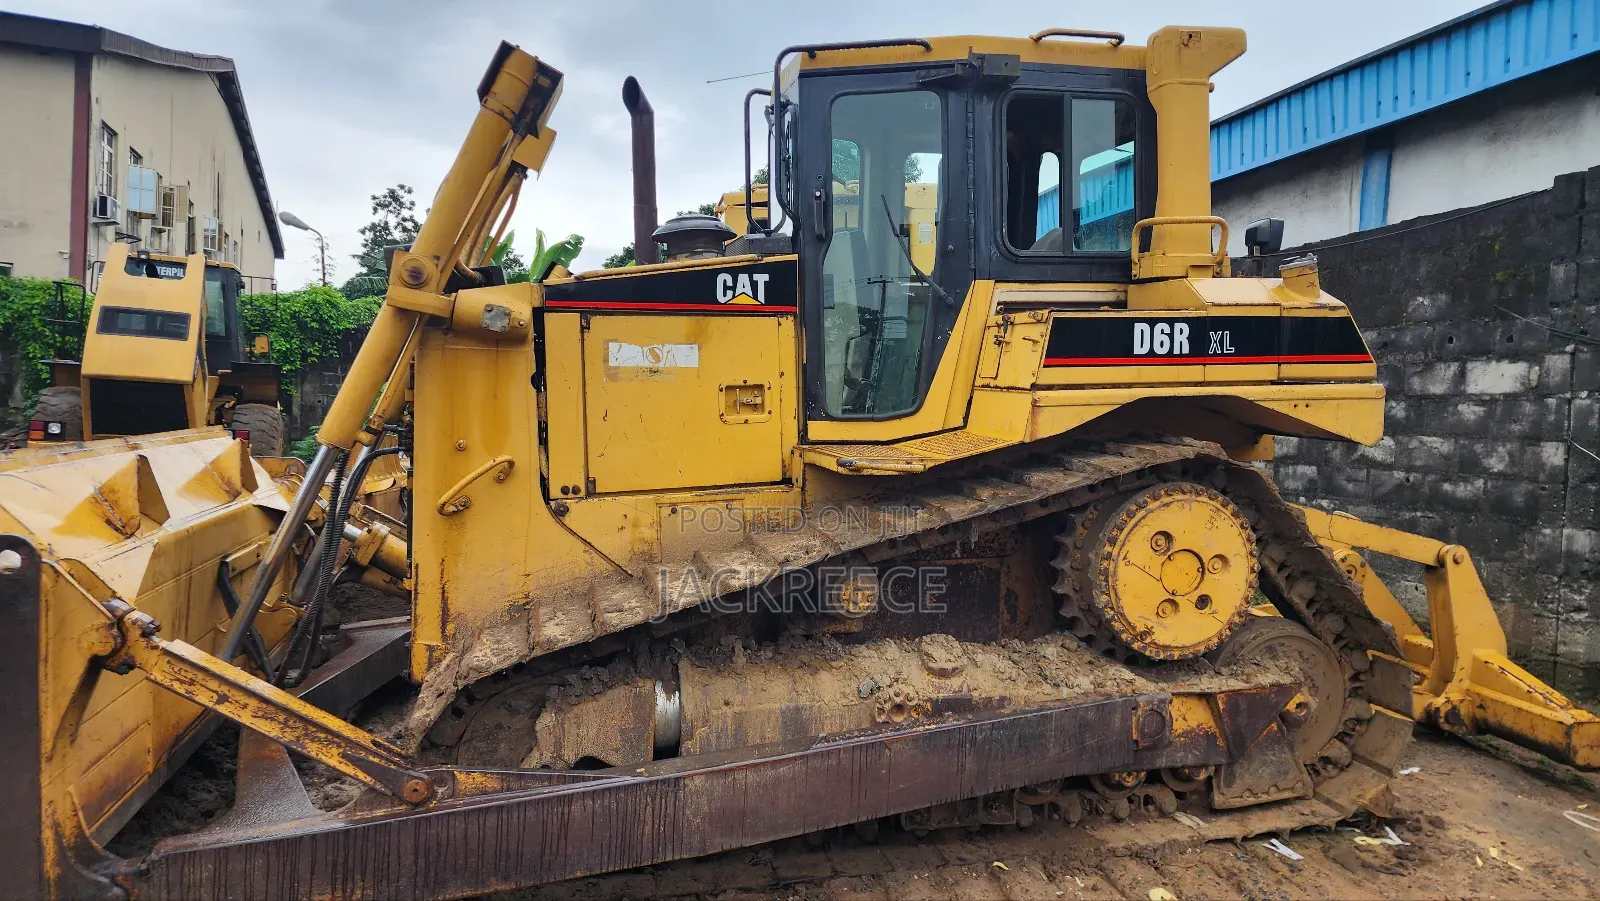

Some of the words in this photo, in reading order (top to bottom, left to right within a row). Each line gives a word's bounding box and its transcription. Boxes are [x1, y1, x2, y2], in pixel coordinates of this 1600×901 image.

[143, 264, 185, 278] TERPIL
[716, 272, 769, 304] CAT
[1133, 322, 1190, 355] D6R
[1208, 330, 1235, 354] XL
